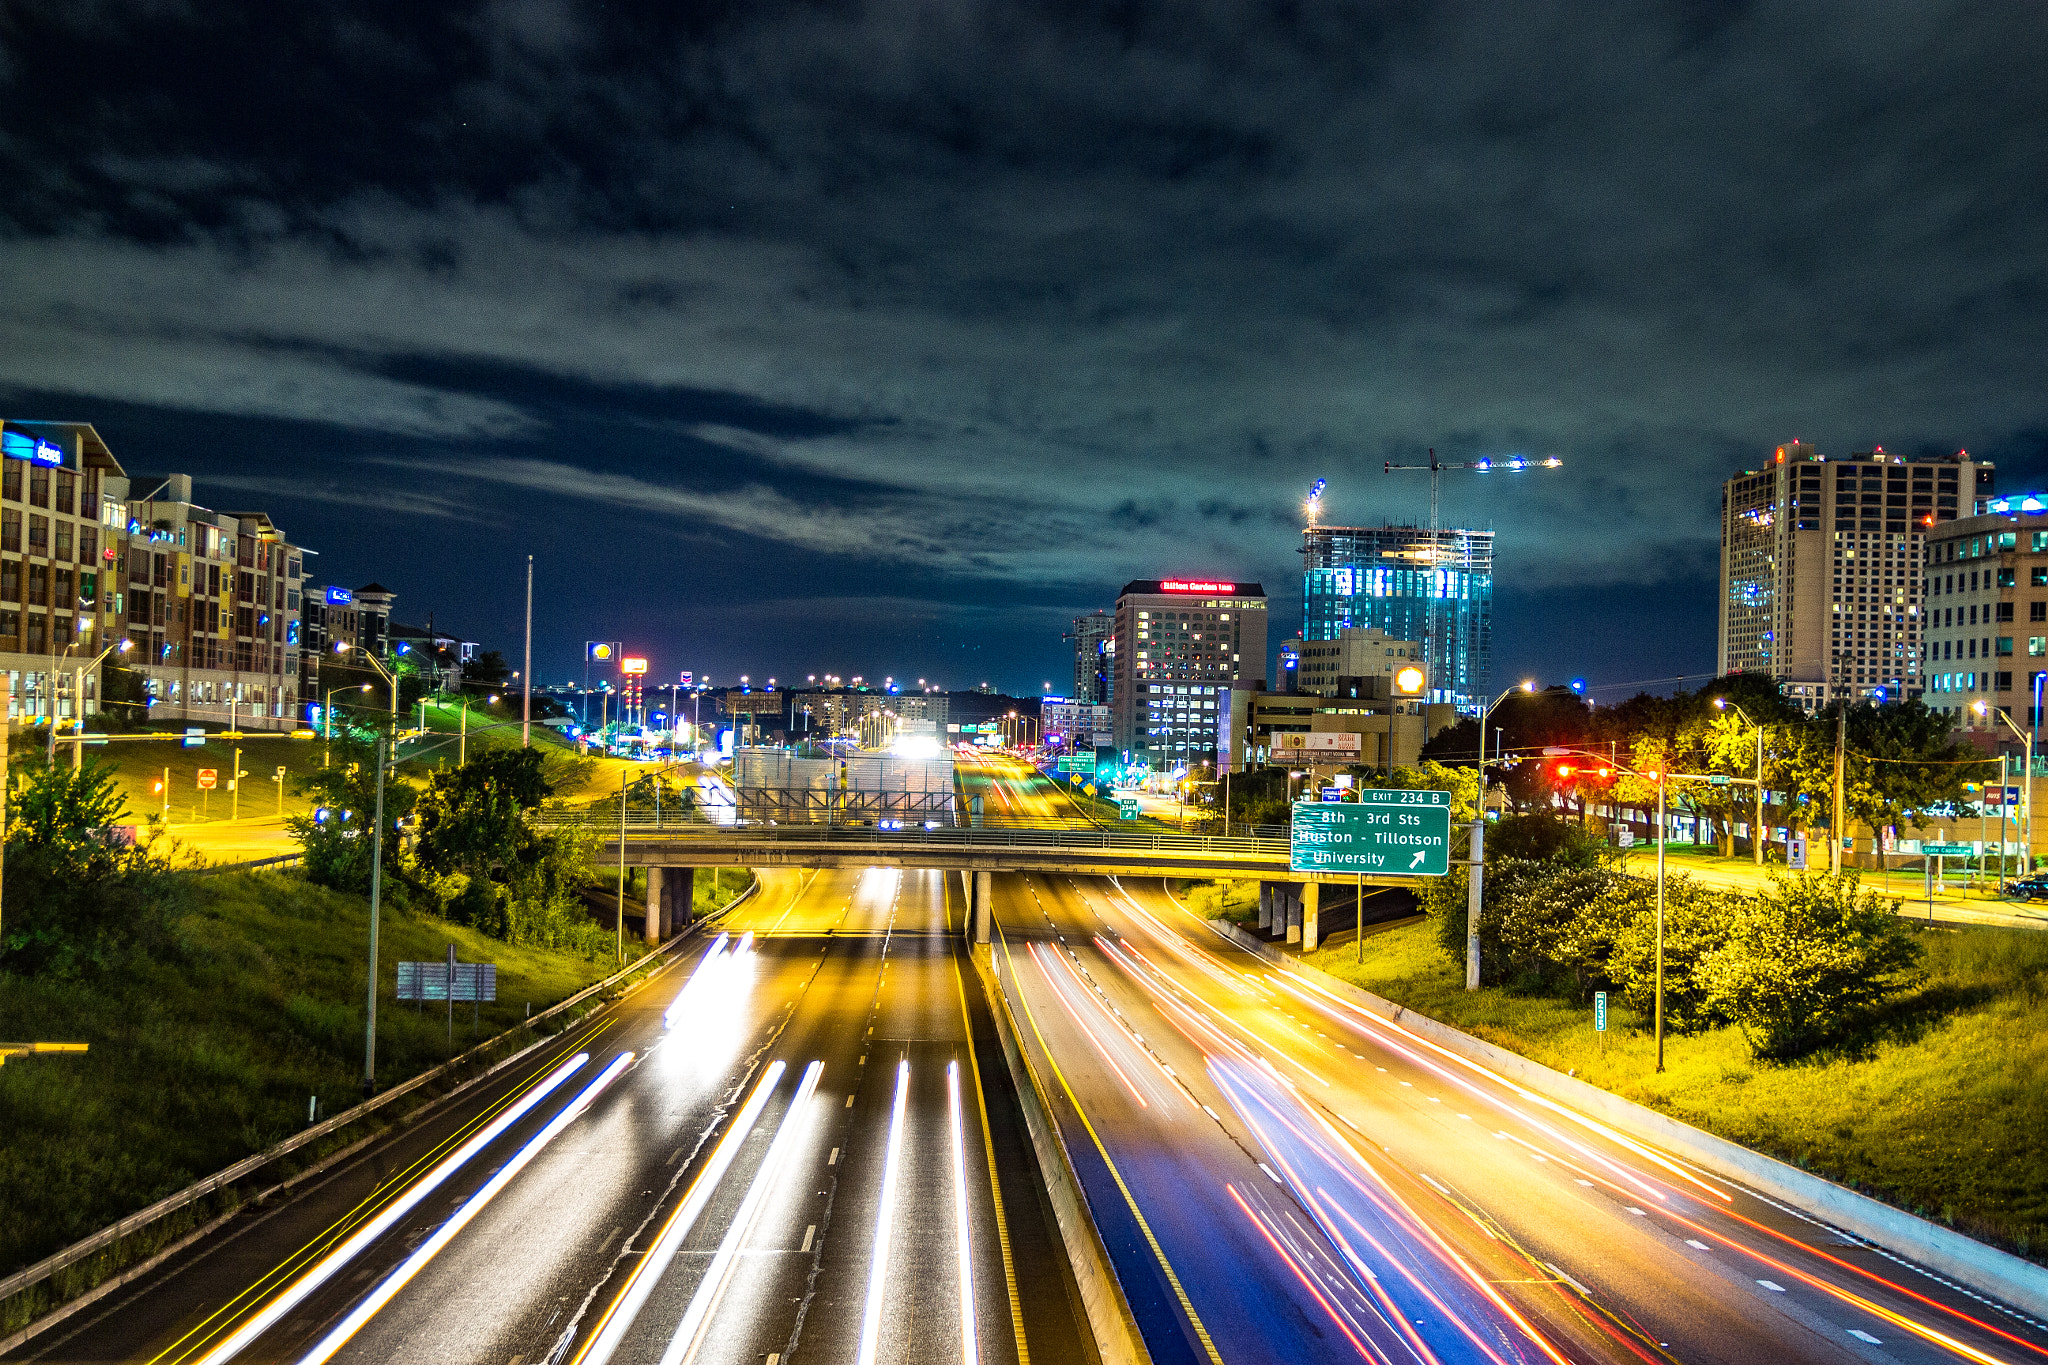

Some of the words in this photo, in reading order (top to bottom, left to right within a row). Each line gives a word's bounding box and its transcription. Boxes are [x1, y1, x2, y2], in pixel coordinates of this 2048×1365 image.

[1163, 582, 1188, 591] Hilton
[1190, 582, 1217, 591] Garden
[1219, 583, 1232, 591] Inn
[1372, 792, 1392, 801] EXIT
[1400, 792, 1424, 804] 234
[1432, 793, 1440, 804] B
[1322, 811, 1345, 823] 8th
[1366, 812, 1390, 824] 3rd
[1398, 813, 1421, 826] Sts
[1299, 831, 1352, 843] Huston
[1374, 832, 1442, 846] Tillotson
[1313, 851, 1385, 867] University
